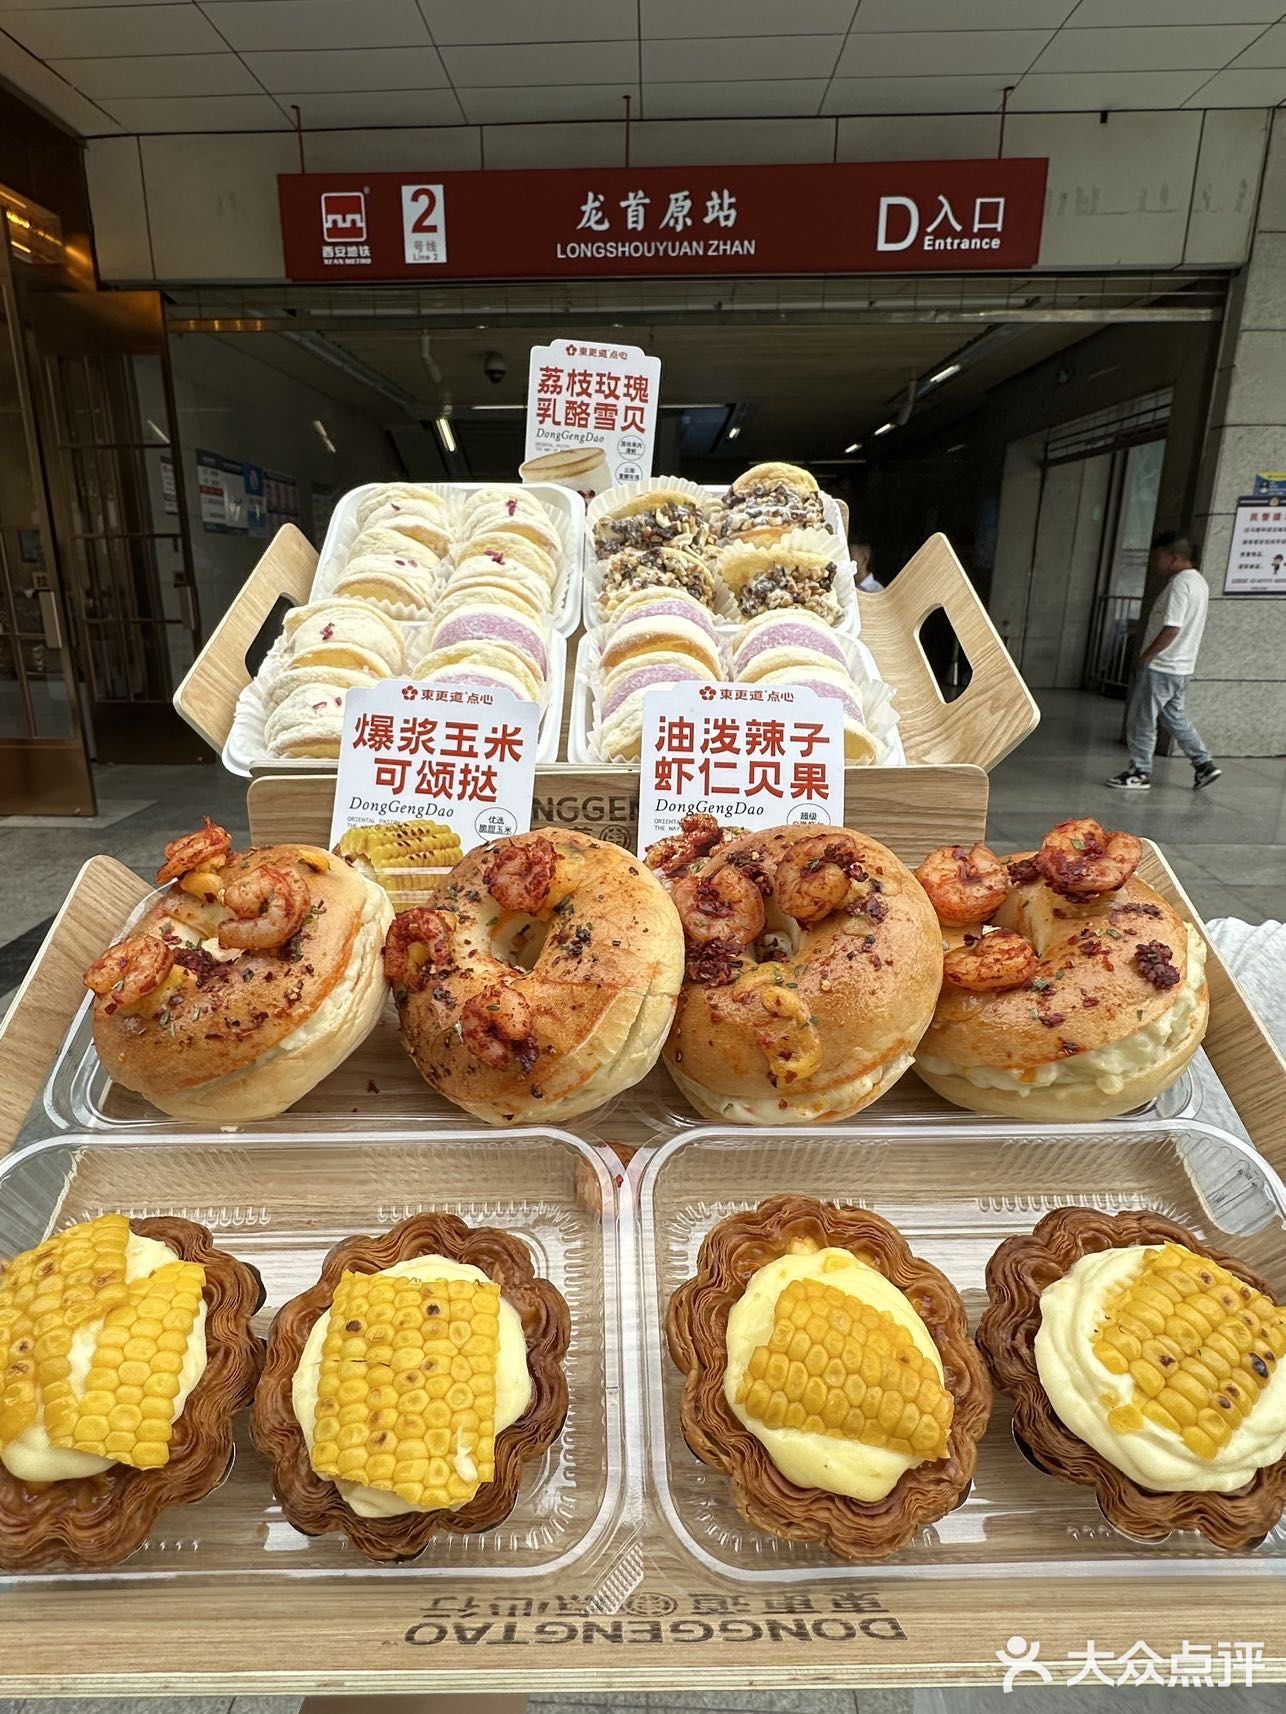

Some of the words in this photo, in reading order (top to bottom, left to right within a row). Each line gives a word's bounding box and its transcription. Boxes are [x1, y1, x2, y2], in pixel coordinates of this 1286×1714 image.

[411, 187, 438, 235] 2
[576, 189, 738, 232] 龙首原站
[876, 196, 920, 252] D
[925, 195, 1005, 233] 入口
[322, 245, 371, 258] 西安地铁
[413, 253, 430, 261] Line
[432, 253, 439, 261] 2
[414, 240, 438, 253] 号线
[556, 241, 704, 258] LONGSHOUYUAN
[708, 240, 756, 256] ZHAN
[923, 236, 1001, 252] Entrance
[537, 366, 648, 404] 荔枝玫瑰
[536, 398, 646, 434] 乳酪雪贝
[536, 428, 605, 444] DongGengDao
[352, 712, 524, 762] 爆浆玉米
[655, 715, 830, 758] 油泼辣子
[374, 757, 498, 803] 可颂挞
[654, 756, 830, 800] 虾仁贝果
[349, 796, 454, 819] DongGengDao
[488, 815, 504, 825] 优选
[655, 798, 764, 816] DongGengDao
[800, 811, 817, 821] 超级
[404, 1616, 907, 1645] DONGGENGTAO
